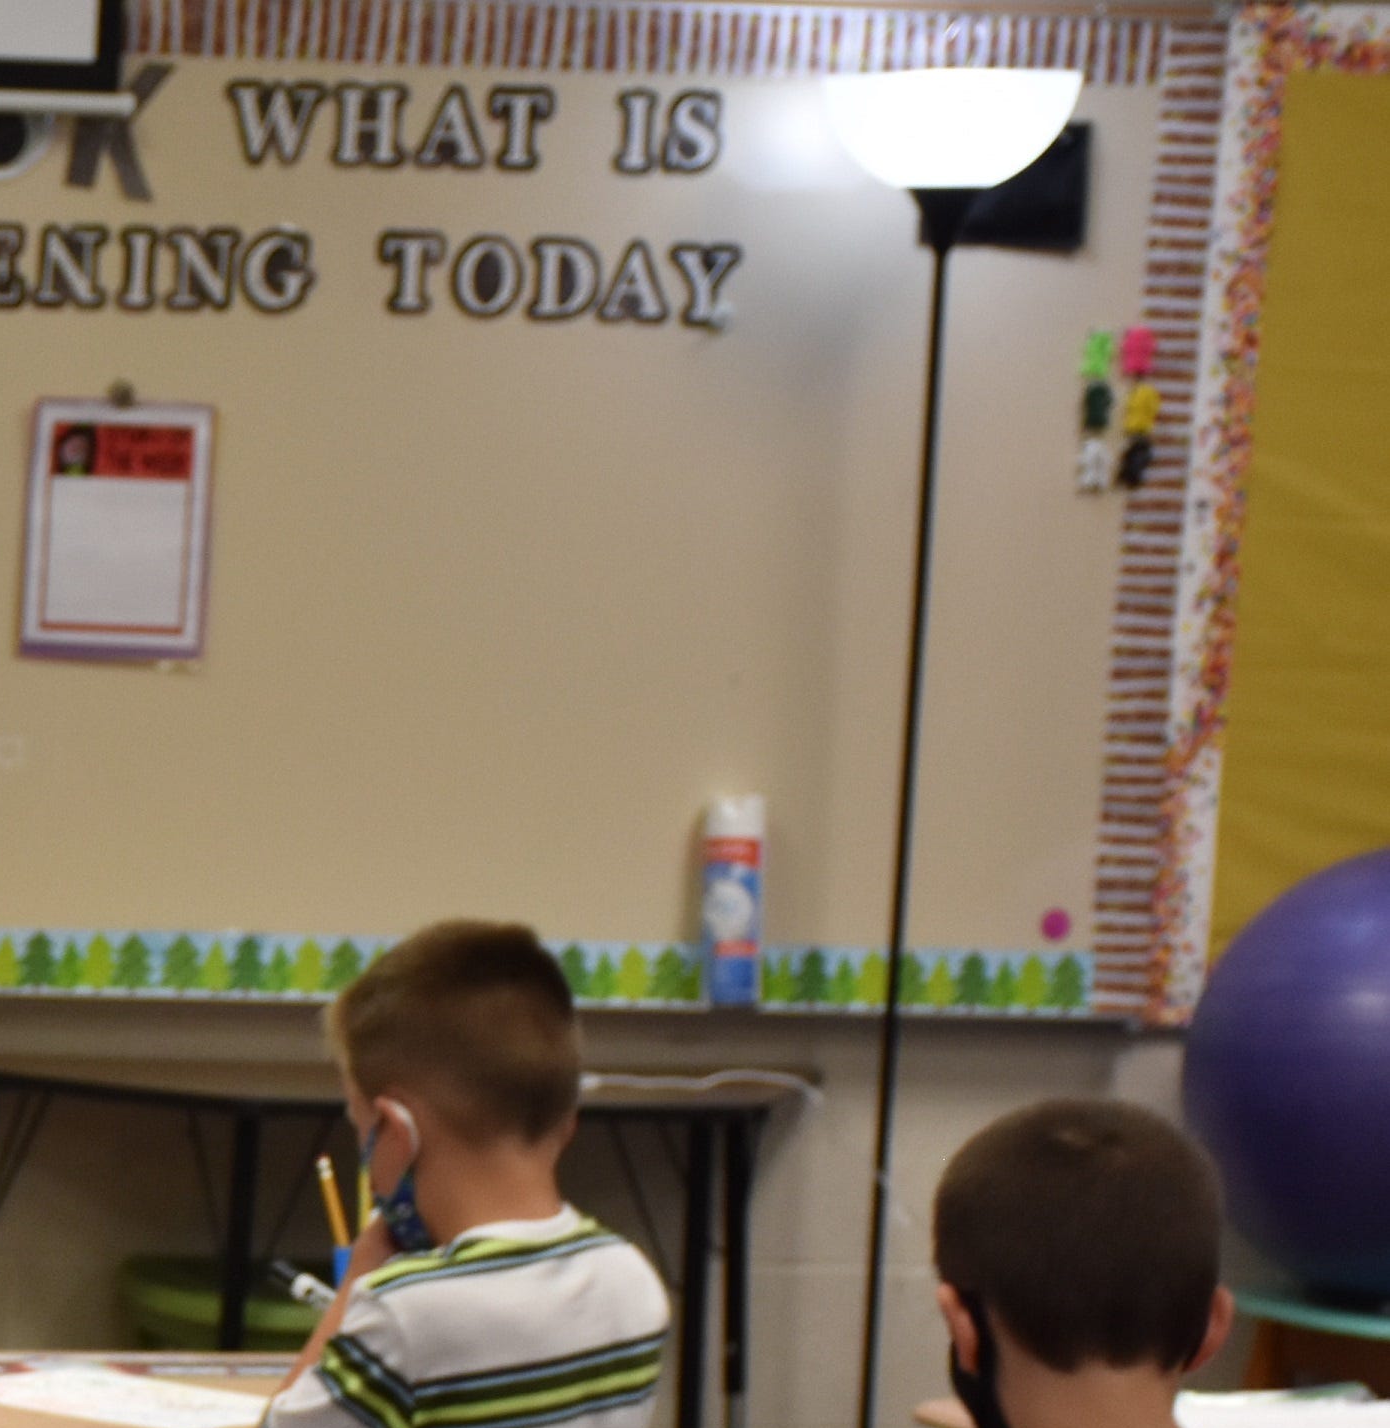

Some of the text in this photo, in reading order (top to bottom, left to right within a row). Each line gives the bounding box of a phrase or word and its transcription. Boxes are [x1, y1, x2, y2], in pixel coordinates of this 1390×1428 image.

[226, 76, 555, 171] WHAT
[615, 87, 725, 175] IS
[378, 228, 741, 330] TODAY
